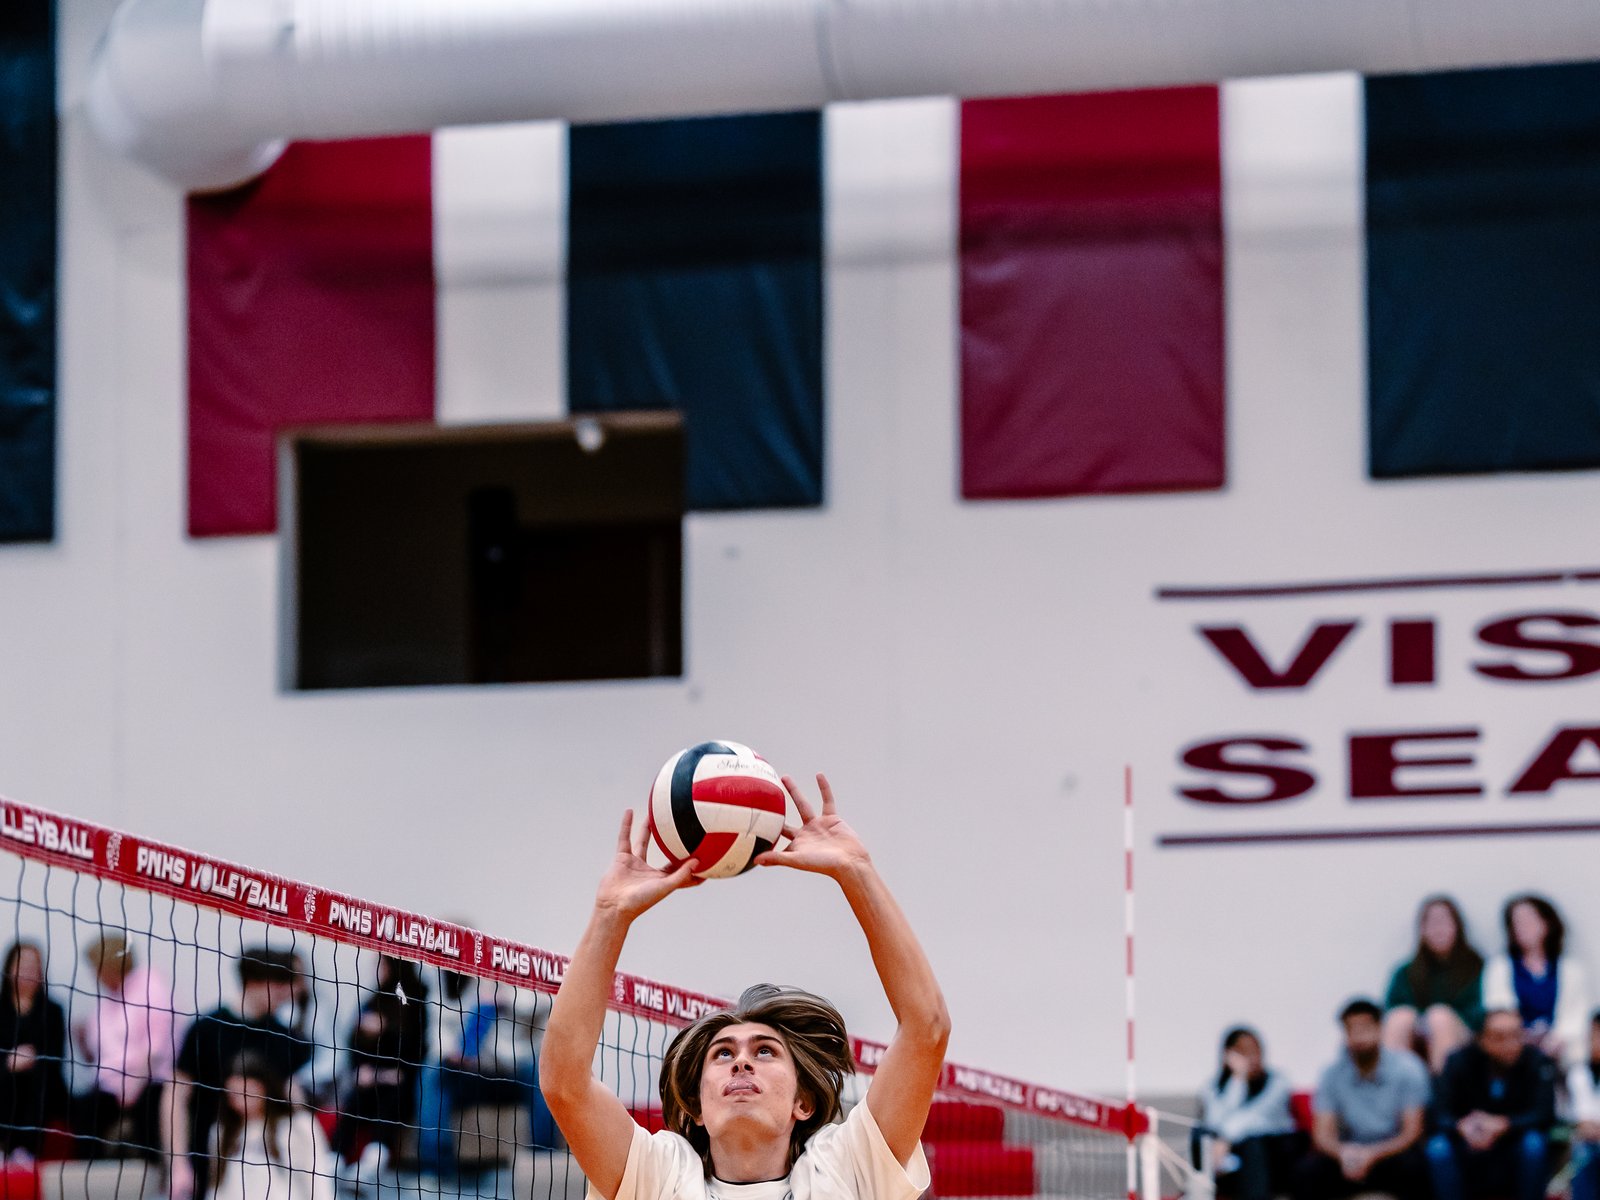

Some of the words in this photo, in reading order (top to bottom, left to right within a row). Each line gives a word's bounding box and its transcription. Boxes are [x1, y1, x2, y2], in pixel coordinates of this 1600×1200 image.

[1196, 612, 1600, 689] VIS
[1175, 725, 1600, 805] SEA
[136, 846, 187, 886] PNHS
[190, 861, 289, 914] VOLLEYBALL
[328, 900, 373, 935] PNHS
[376, 912, 461, 958] VOLLEYBALL
[492, 946, 531, 976] PNHS
